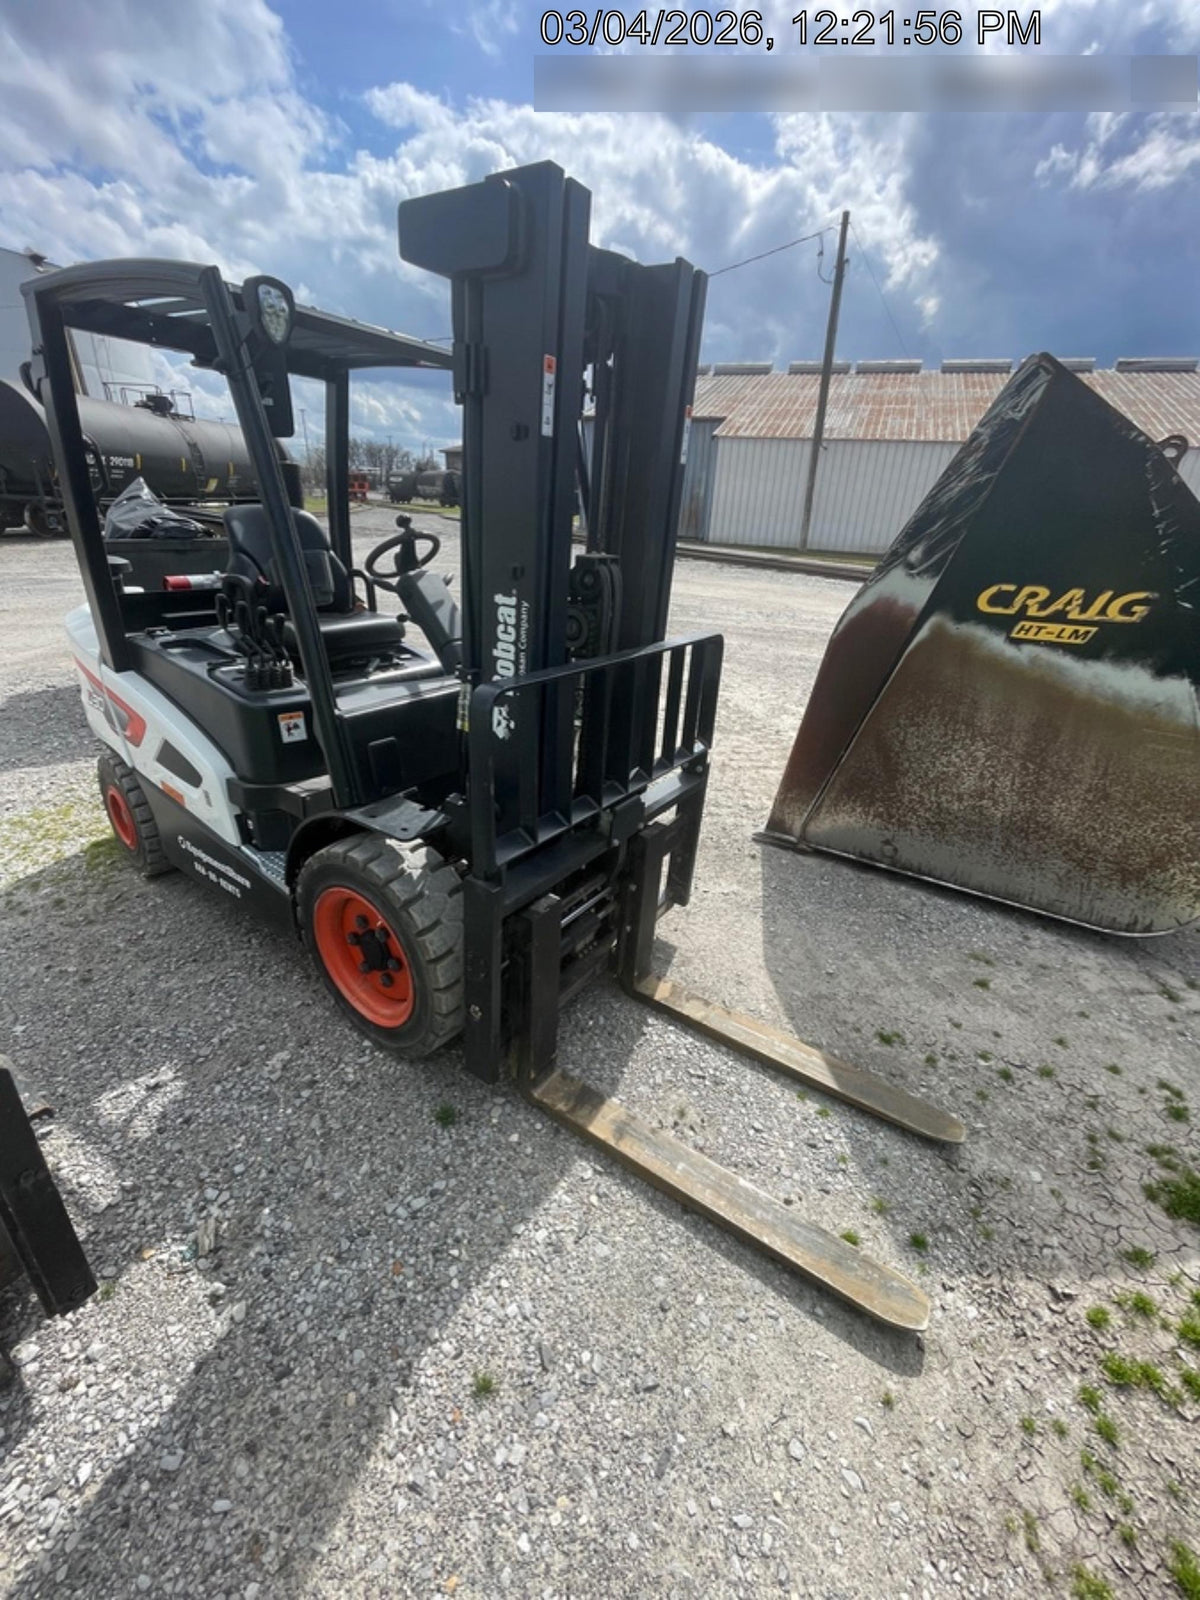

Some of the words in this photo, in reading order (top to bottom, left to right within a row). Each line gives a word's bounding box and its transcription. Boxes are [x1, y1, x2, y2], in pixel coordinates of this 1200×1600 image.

[977, 584, 1158, 622] CRAIG
[518, 600, 530, 649] Company
[1015, 624, 1093, 641] HT-LM
